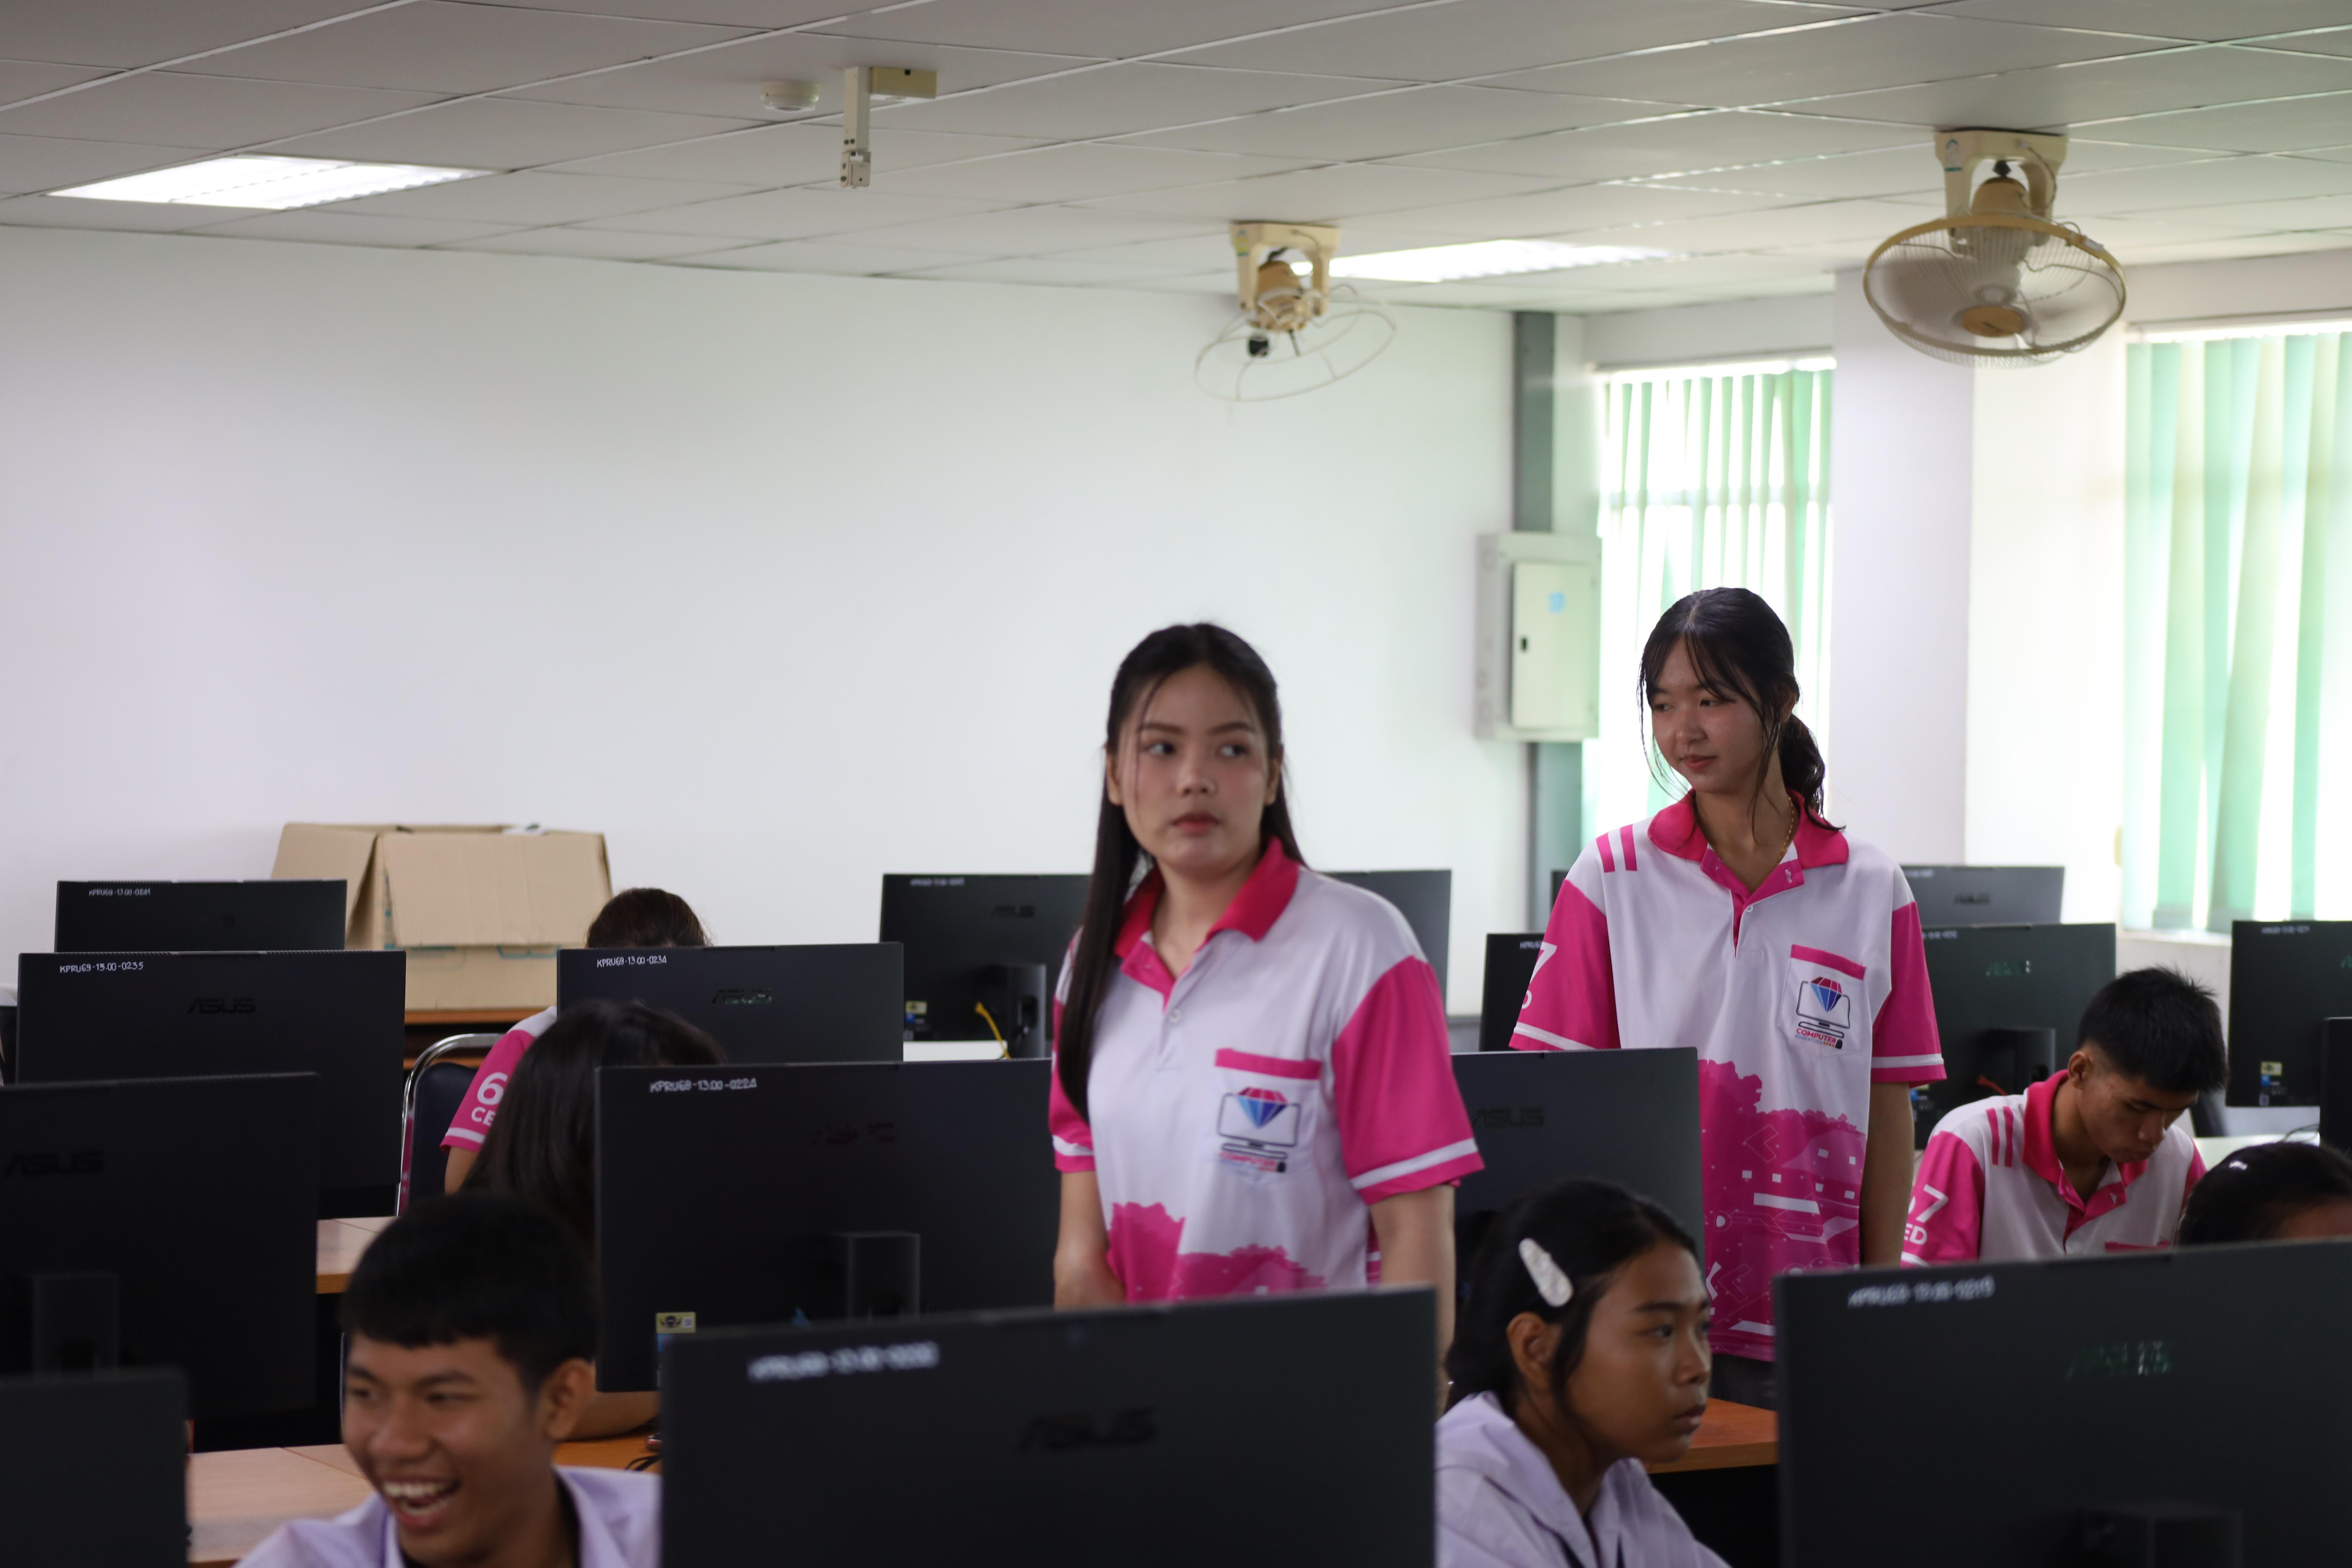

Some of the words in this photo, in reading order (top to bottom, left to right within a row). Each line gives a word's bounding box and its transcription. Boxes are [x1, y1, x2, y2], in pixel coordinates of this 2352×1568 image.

[711, 988, 772, 1004] ASUS
[187, 998, 256, 1014] ASUS
[1796, 1027, 1836, 1044] COMPUTER
[1473, 1107, 1544, 1128] ASUS
[5, 1150, 104, 1176] ASUS
[1904, 1223, 1927, 1245] ED
